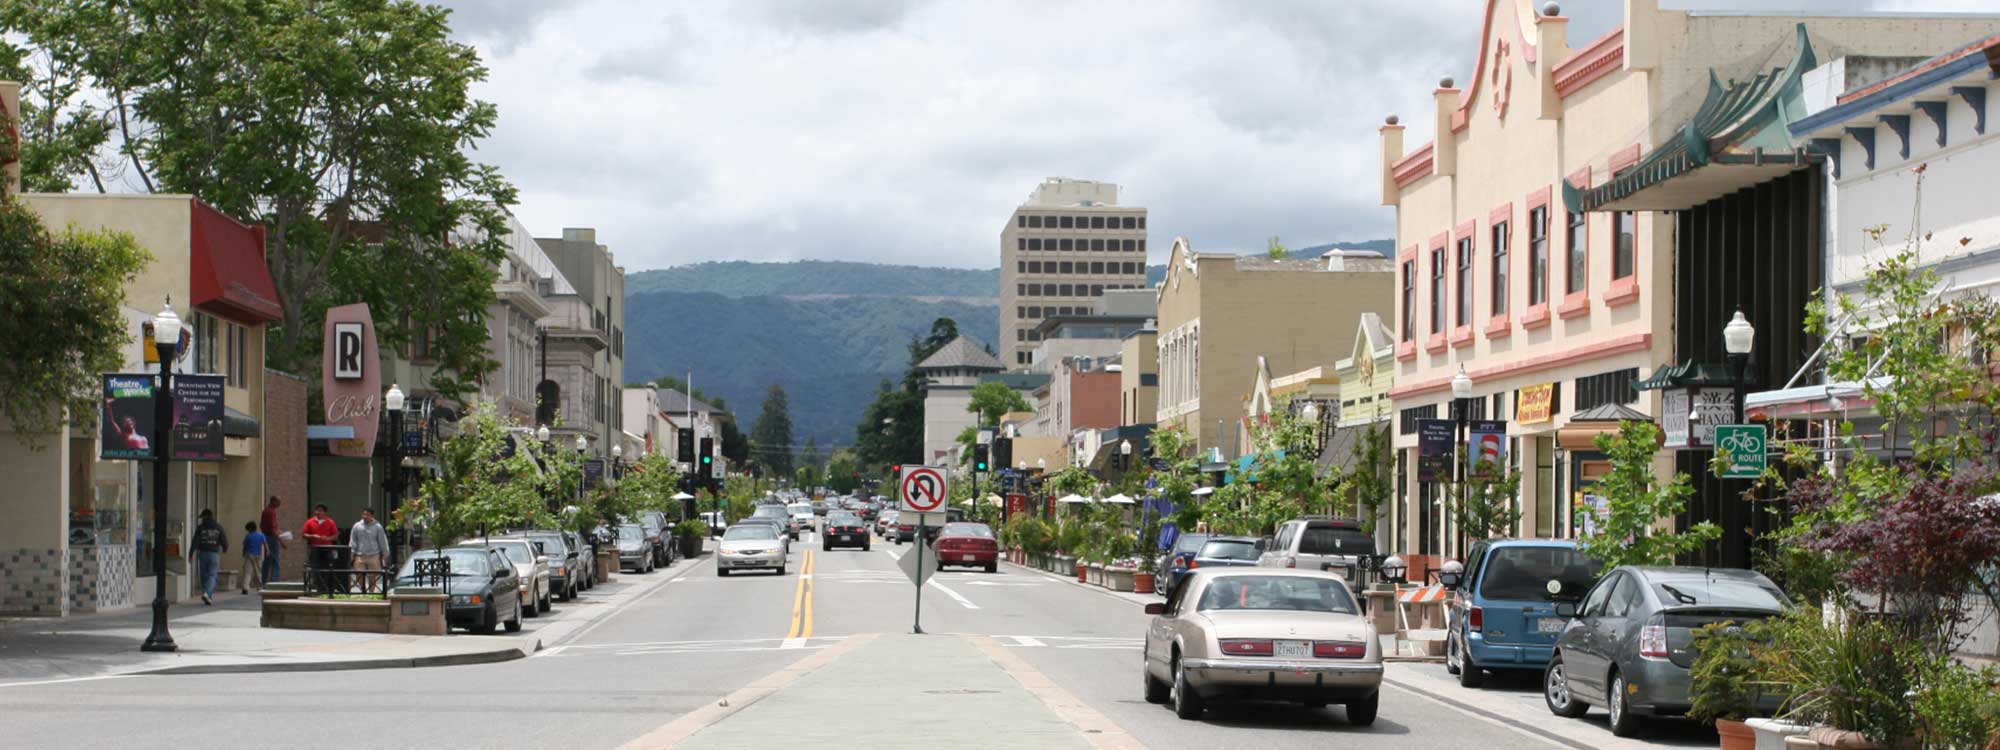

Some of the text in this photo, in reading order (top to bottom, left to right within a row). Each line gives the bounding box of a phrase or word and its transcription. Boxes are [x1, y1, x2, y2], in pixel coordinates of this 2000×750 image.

[340, 331, 360, 371] R
[109, 377, 140, 389] Theatre
[1738, 454, 1763, 463] ROUTE
